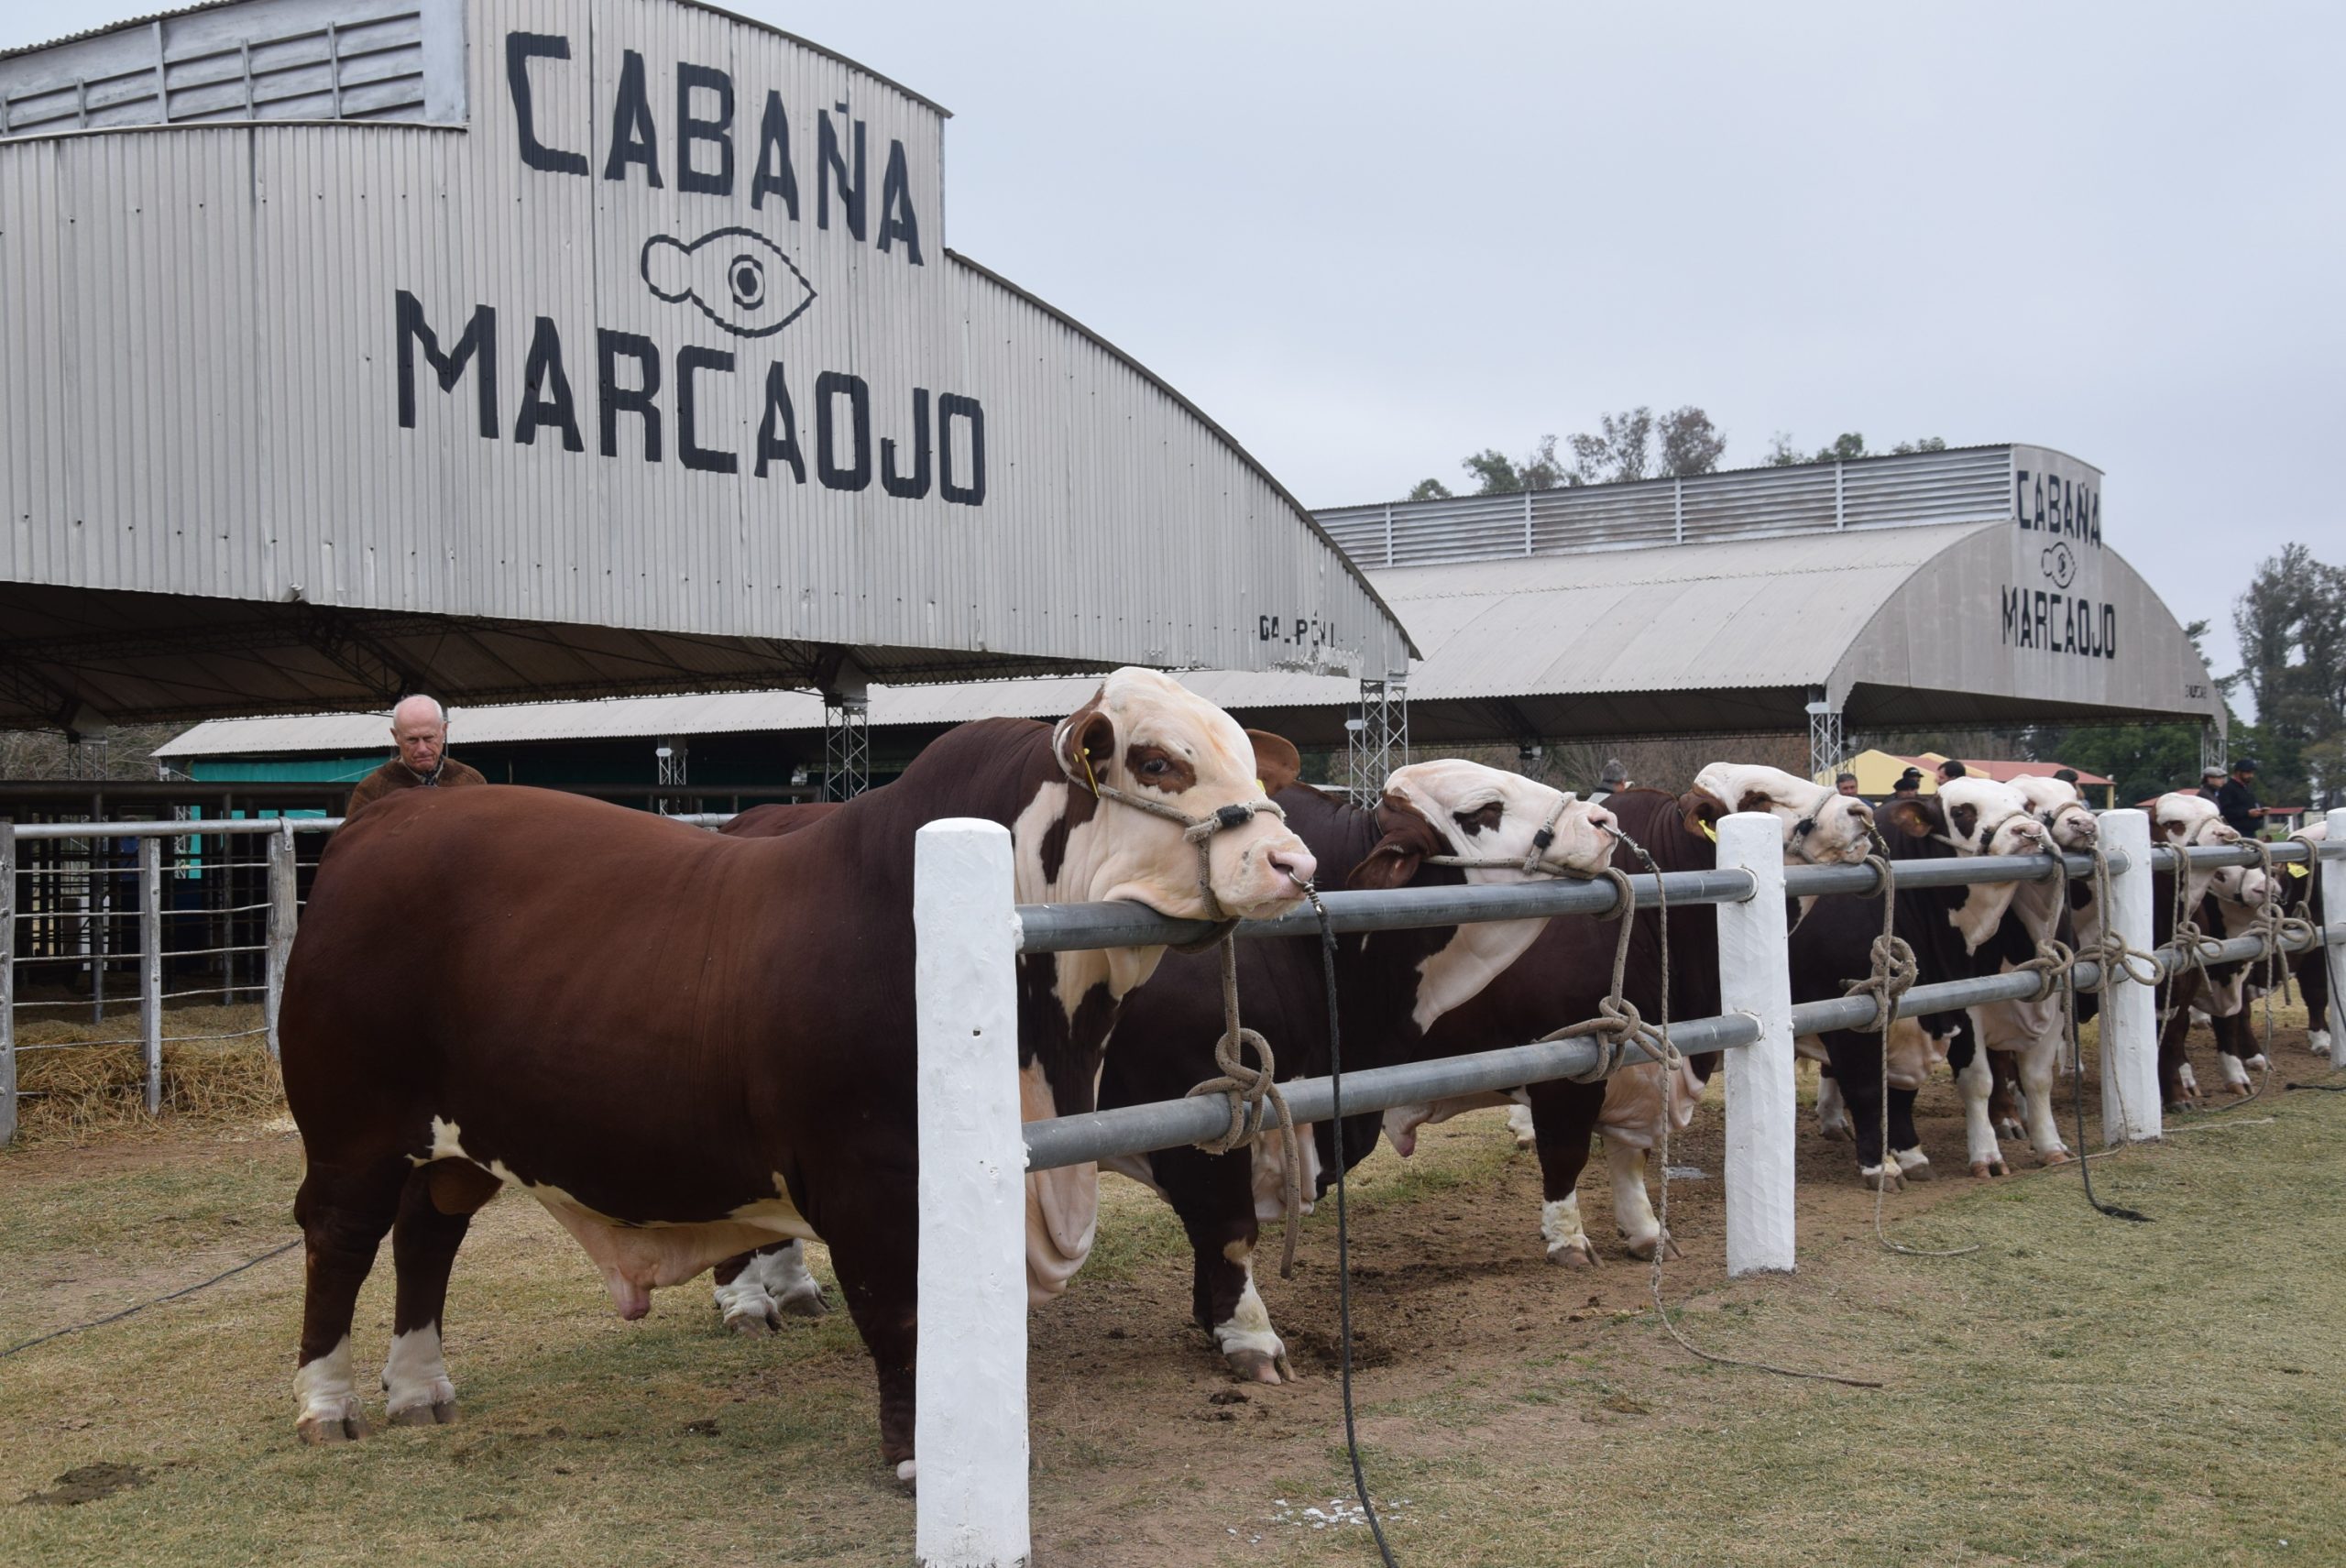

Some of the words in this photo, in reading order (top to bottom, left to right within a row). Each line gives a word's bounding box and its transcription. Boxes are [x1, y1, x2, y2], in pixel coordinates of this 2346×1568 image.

[507, 31, 924, 267] CABAÑA
[396, 289, 985, 506] MARCAOJO
[2017, 470, 2100, 550] CABAÑA
[2002, 584, 2115, 659] MARCAOJO
